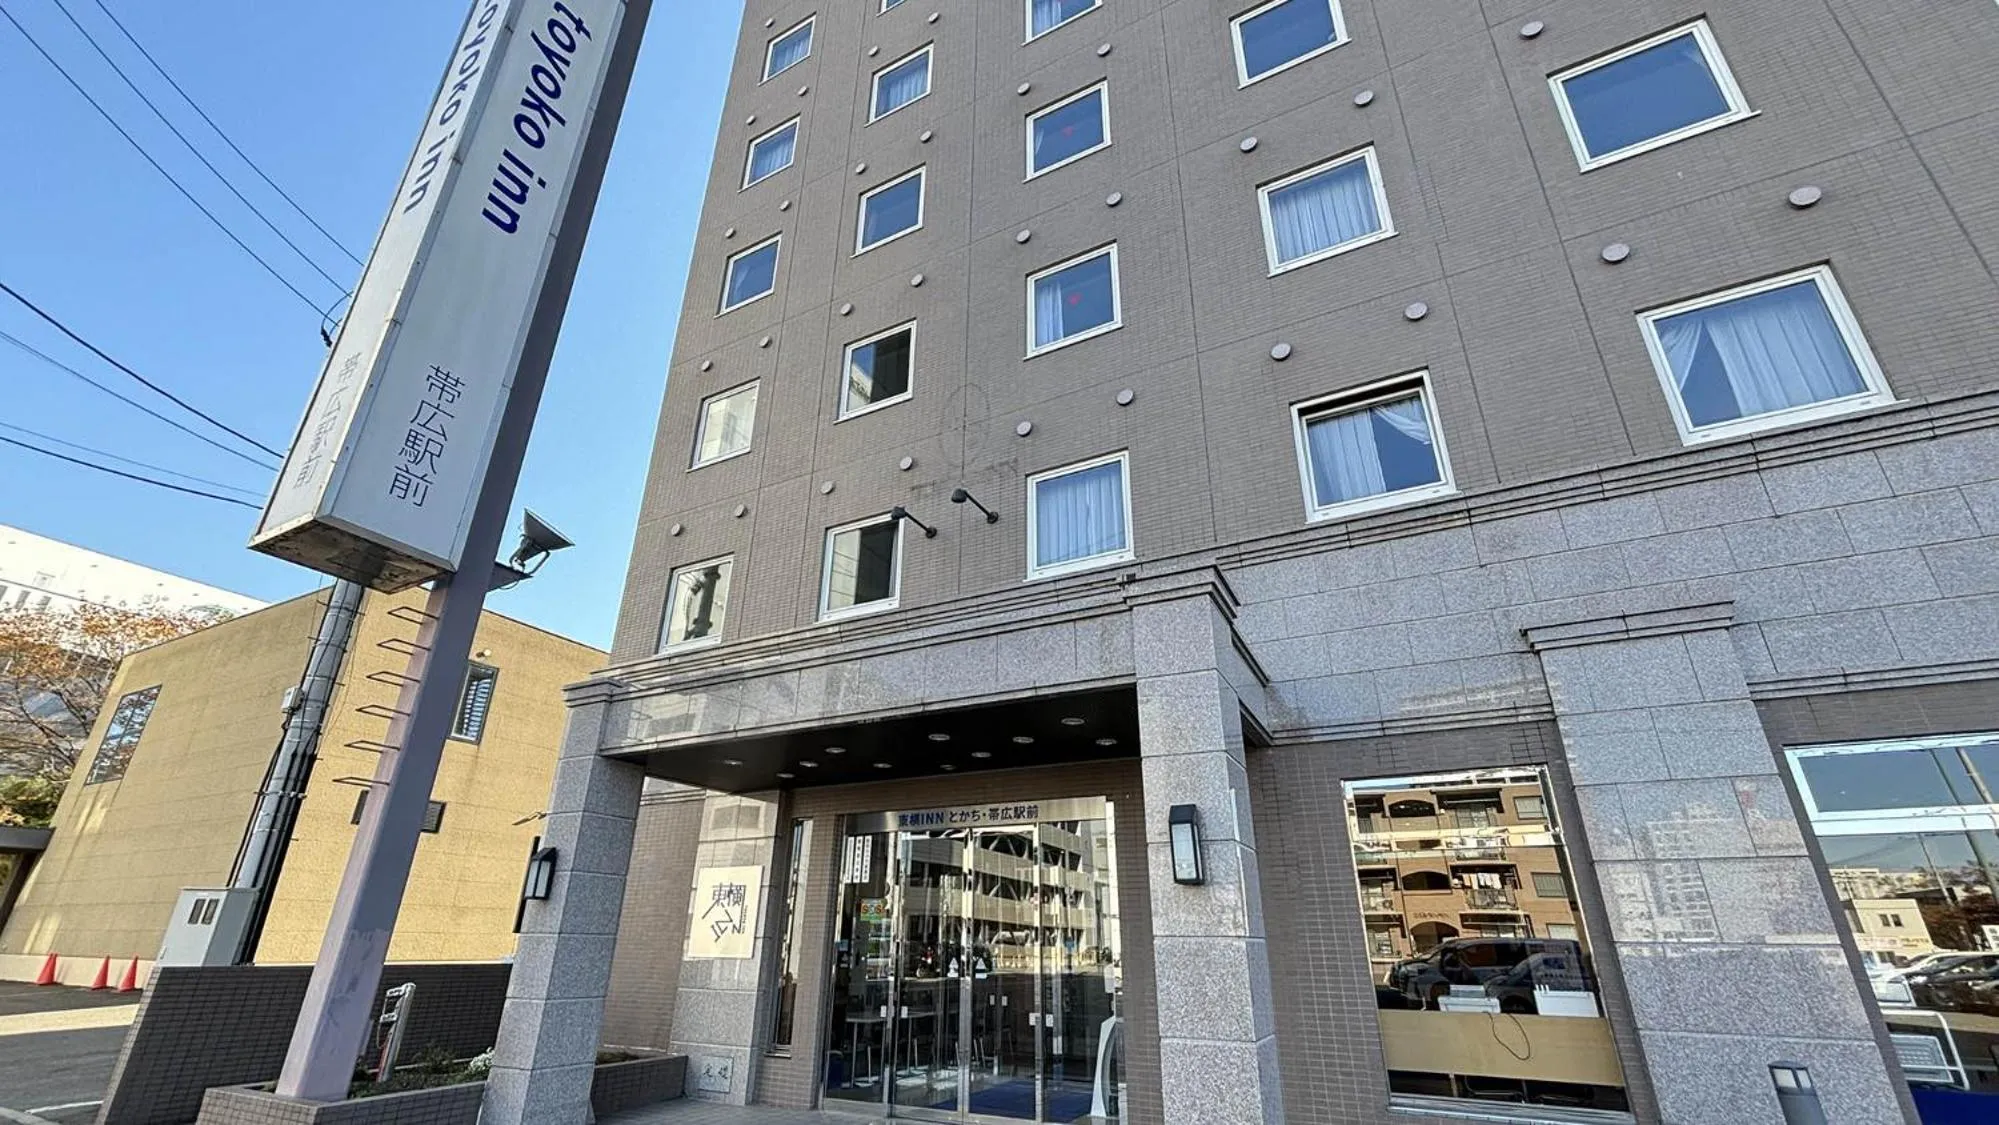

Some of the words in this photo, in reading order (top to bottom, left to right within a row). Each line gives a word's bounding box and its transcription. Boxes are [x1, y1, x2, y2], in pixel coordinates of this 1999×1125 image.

[438, 0, 499, 126] oyoko
[513, 1, 593, 150] toyoko
[403, 130, 455, 214] inn
[481, 148, 547, 235] inn
[388, 364, 466, 508] 帯広駅前
[948, 804, 1040, 824] とかち・帯広駅前
